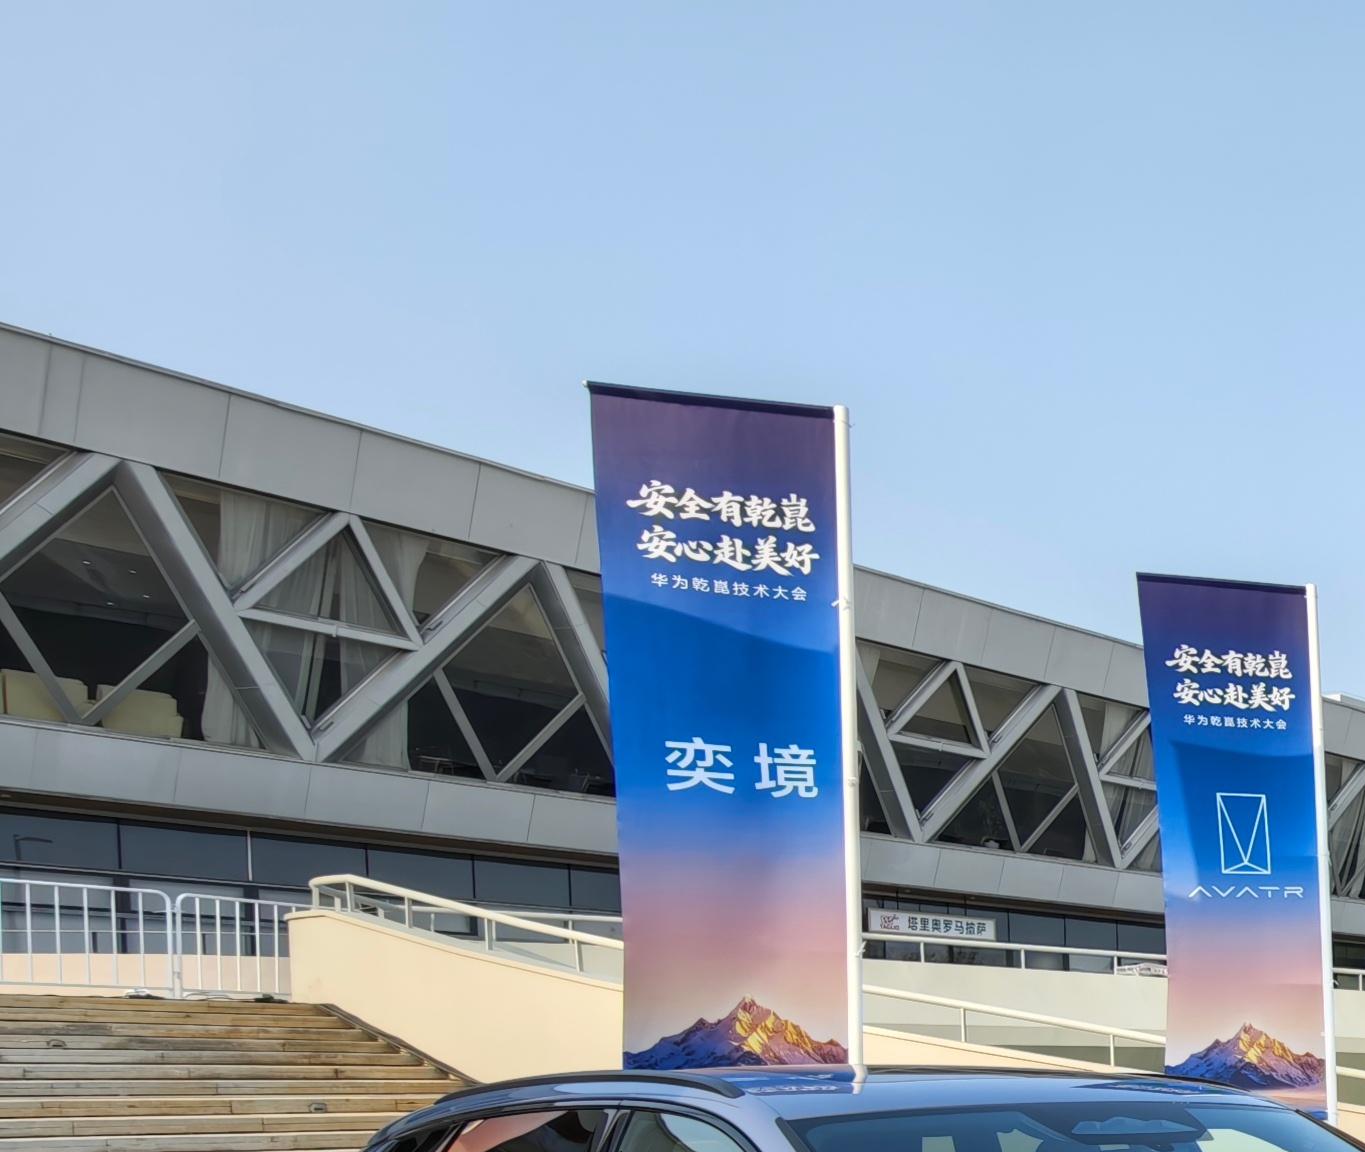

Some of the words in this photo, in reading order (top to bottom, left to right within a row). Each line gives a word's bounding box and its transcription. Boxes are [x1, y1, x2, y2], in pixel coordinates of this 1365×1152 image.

[627, 480, 815, 532] 安全有乾崑
[636, 525, 820, 577] 安心赴美好
[1165, 644, 1293, 680] 安全有乾崑
[1173, 678, 1296, 712] 安心赴美好
[664, 737, 819, 799] 奕境
[1188, 885, 1304, 899] AVATR
